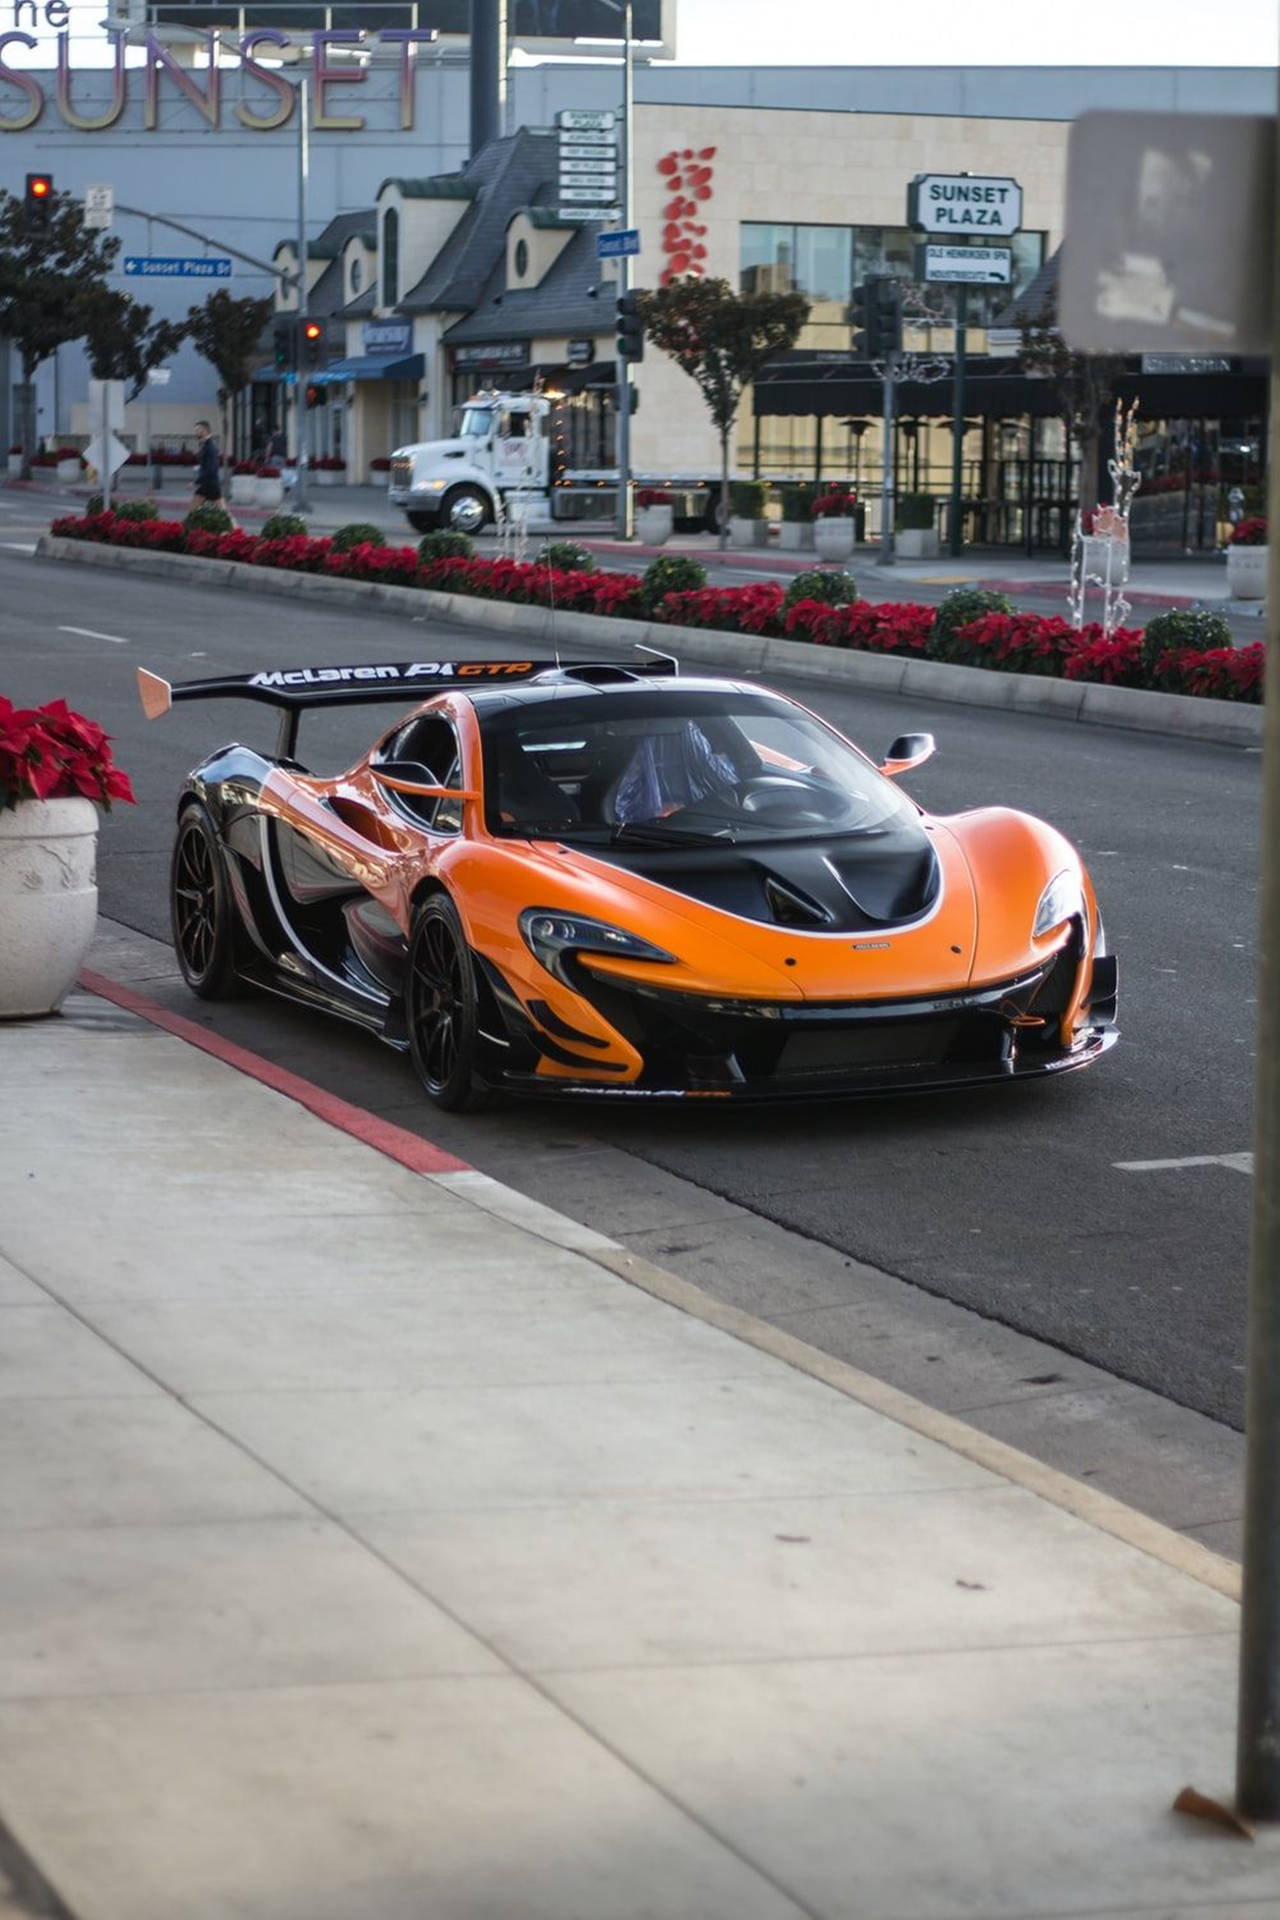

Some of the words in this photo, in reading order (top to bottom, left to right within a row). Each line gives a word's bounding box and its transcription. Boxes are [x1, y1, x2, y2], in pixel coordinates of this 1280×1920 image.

[0, 28, 440, 131] SUNSET
[929, 184, 1010, 204] SUNSET
[935, 207, 1003, 226] PLAZA
[142, 260, 181, 273] Sunset
[183, 261, 215, 275] Plaza
[248, 665, 405, 685] McLaren
[458, 662, 532, 675] GTR
